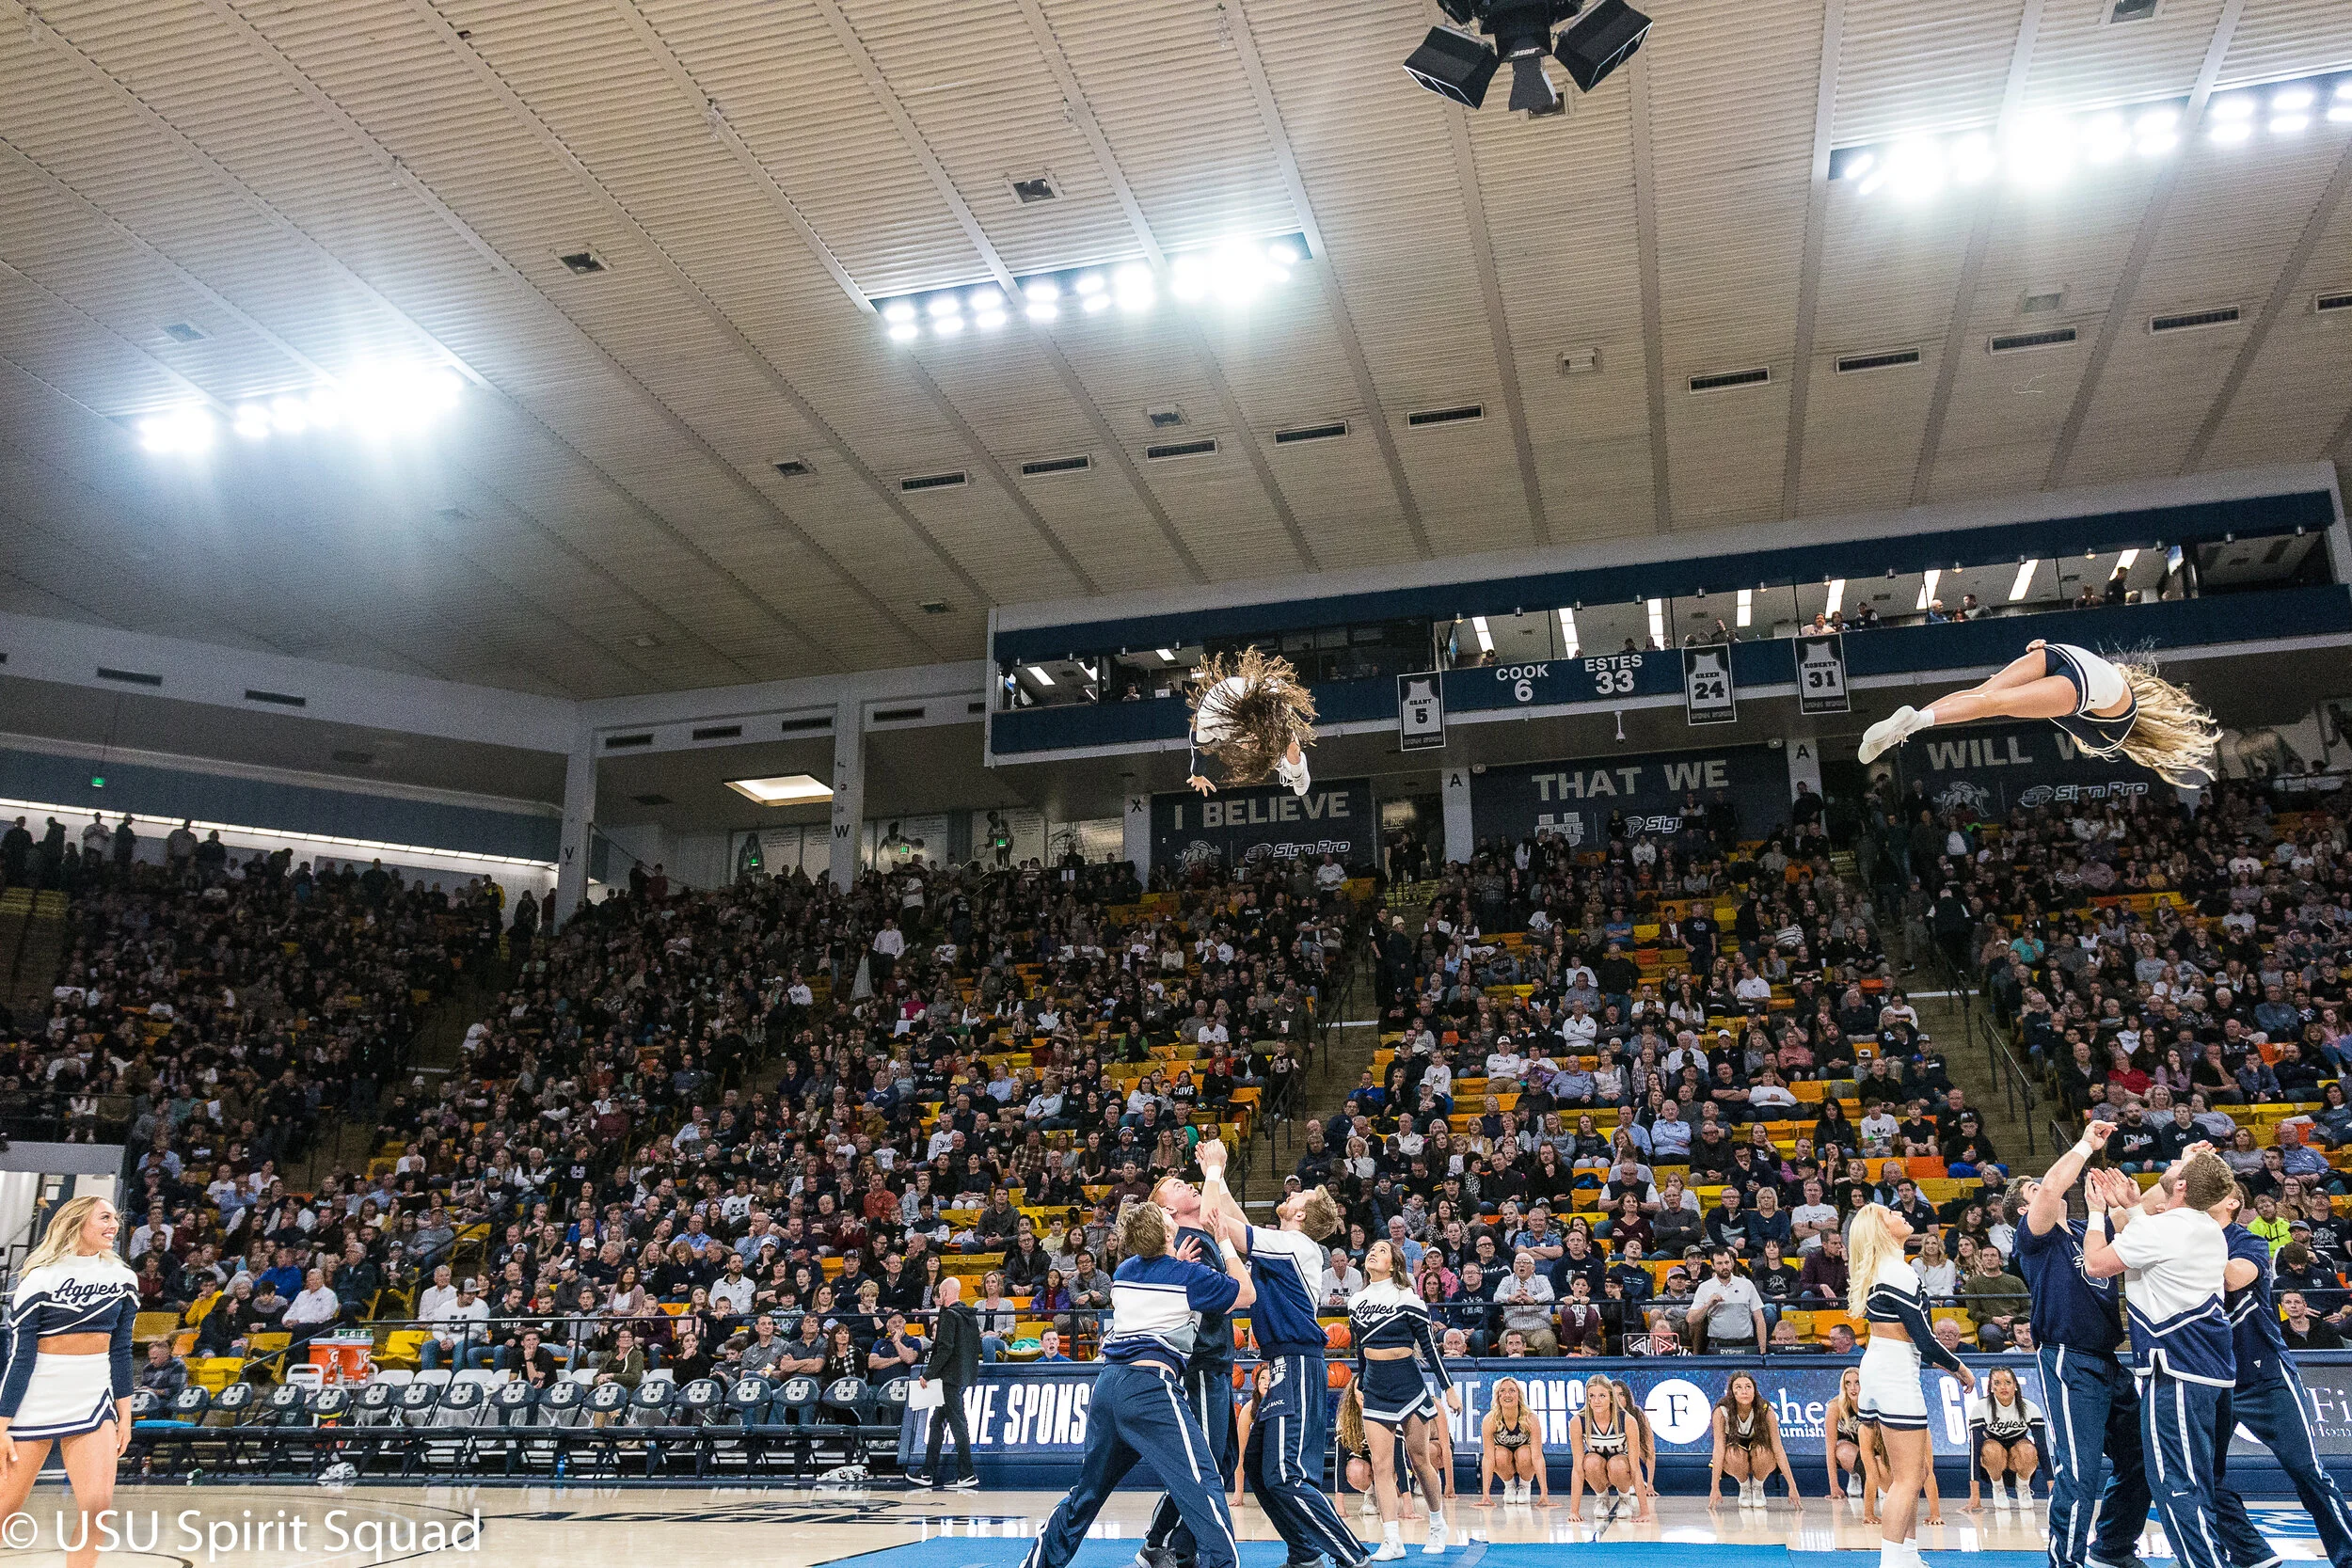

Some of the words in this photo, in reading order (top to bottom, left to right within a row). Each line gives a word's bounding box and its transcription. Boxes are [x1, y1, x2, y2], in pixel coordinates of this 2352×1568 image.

[1495, 664, 1549, 681] COOK
[1584, 655, 1643, 673] ESTES
[1596, 670, 1635, 694] 33
[1808, 670, 1836, 689] 31
[1514, 679, 1534, 702] 6
[1694, 681, 1724, 700] 24
[1415, 707, 1428, 724] 5
[1797, 744, 1809, 759] A
[1927, 736, 2033, 770] WILL
[1450, 773, 1463, 788] A
[1531, 767, 1642, 801] THAT
[1663, 759, 1729, 791] WE
[1131, 799, 1142, 813] X
[1203, 791, 1350, 828] BELIEVE
[834, 824, 850, 838] W
[1316, 840, 1351, 853] Pro
[54, 1277, 121, 1305] Aggies
[1356, 1299, 1395, 1321] Aggies
[1668, 1394, 1690, 1427] F
